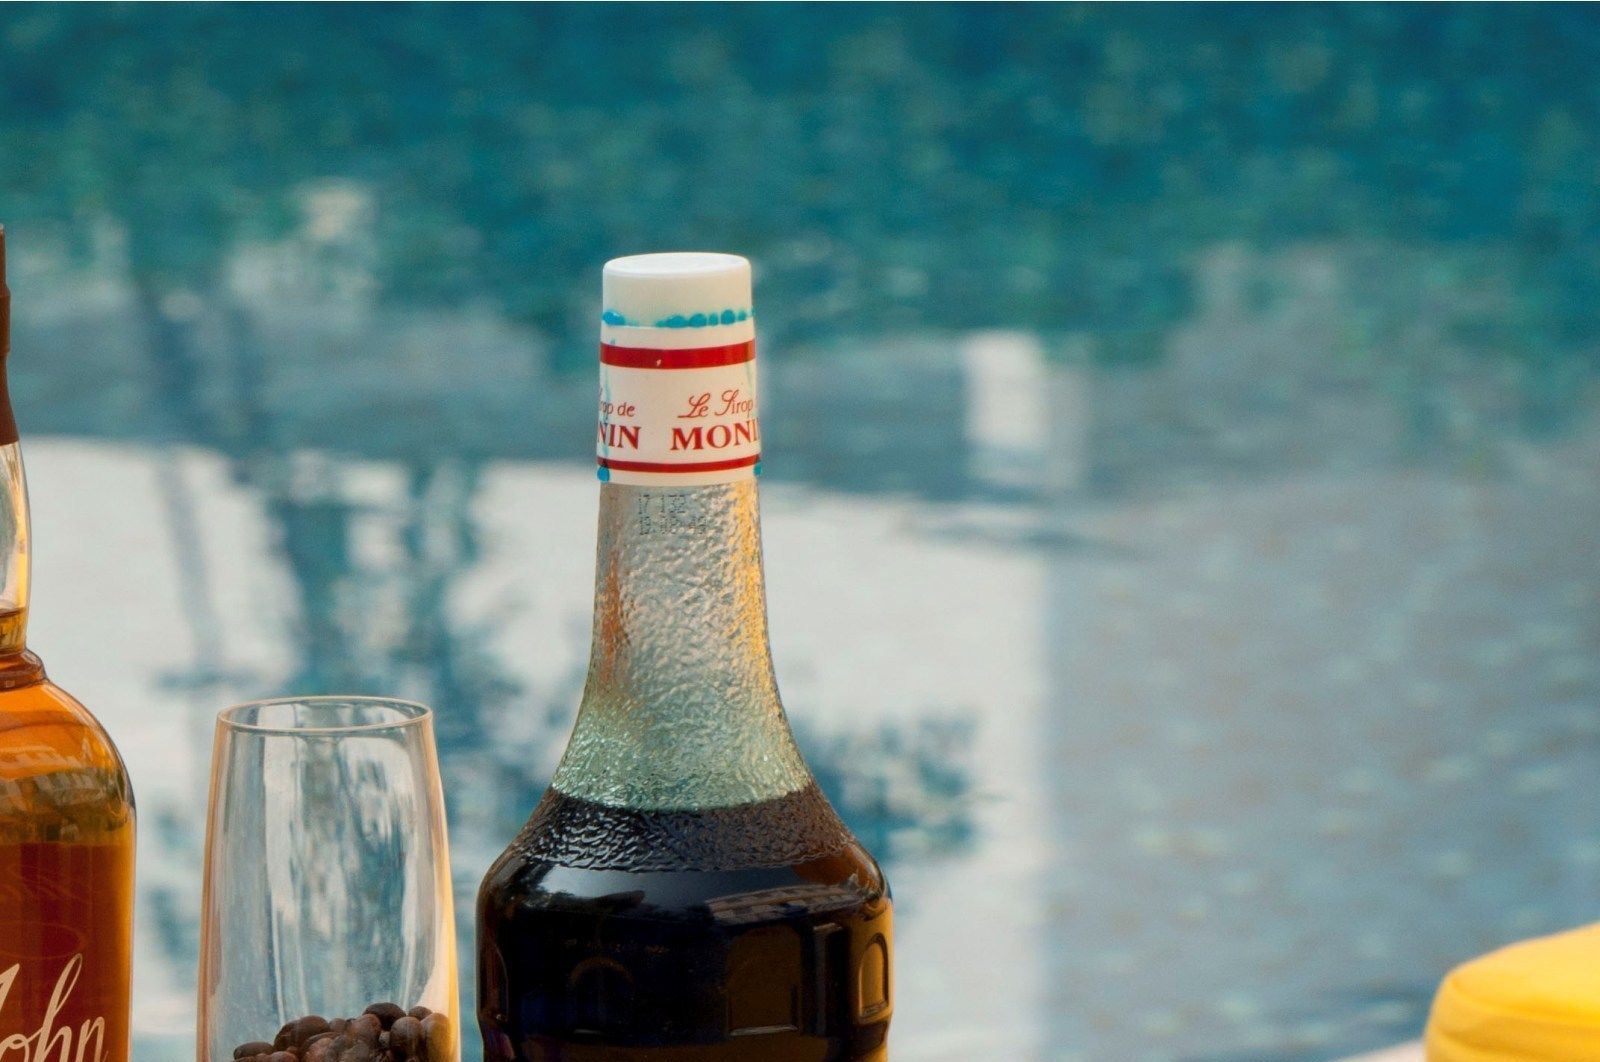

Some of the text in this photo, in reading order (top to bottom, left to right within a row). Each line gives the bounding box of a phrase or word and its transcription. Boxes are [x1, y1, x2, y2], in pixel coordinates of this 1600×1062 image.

[617, 401, 636, 418] de
[677, 389, 753, 418] Le Sirop
[669, 417, 760, 451] MONI
